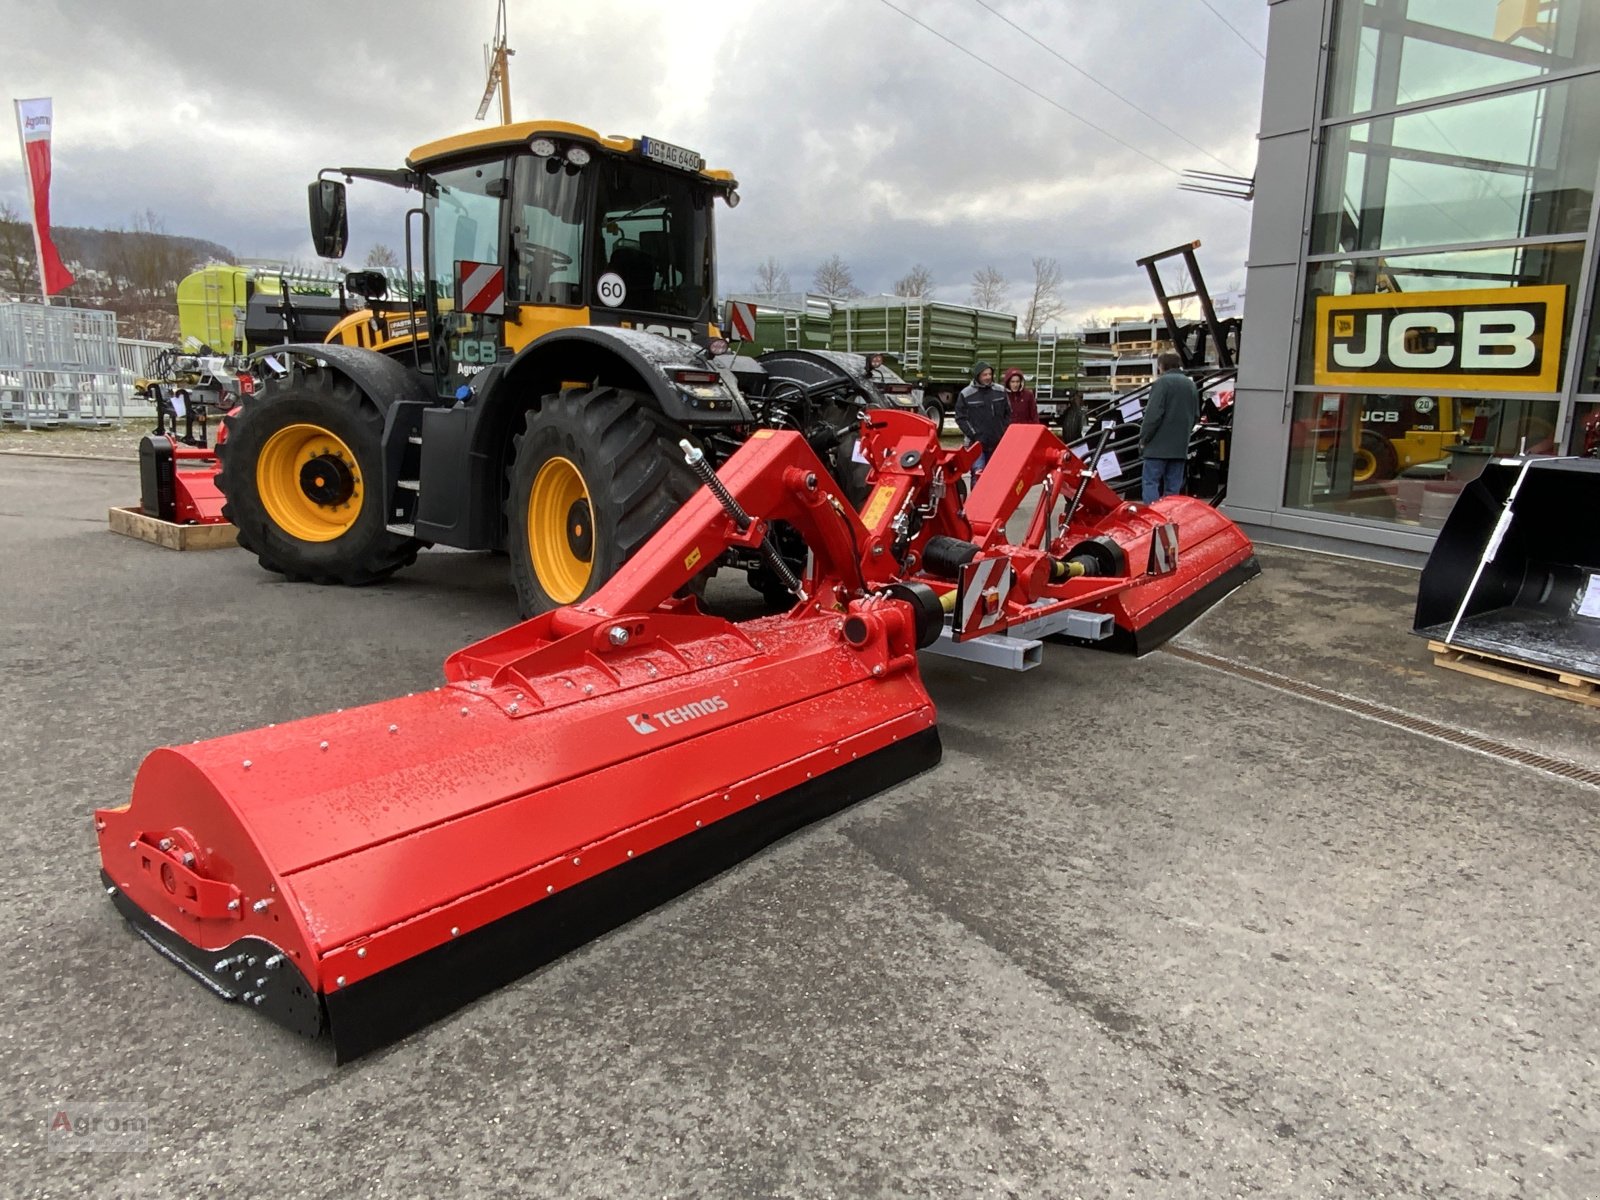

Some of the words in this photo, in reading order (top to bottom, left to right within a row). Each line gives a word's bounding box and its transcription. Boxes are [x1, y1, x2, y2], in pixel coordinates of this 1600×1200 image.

[648, 141, 660, 157] OG
[666, 146, 677, 162] AG
[678, 151, 699, 169] 6460
[601, 281, 623, 298] 60
[1333, 310, 1535, 369] JCB
[451, 340, 497, 363] JCB
[1418, 400, 1430, 409] 20
[1360, 411, 1399, 422] JCB
[653, 695, 729, 728] TEHNOS
